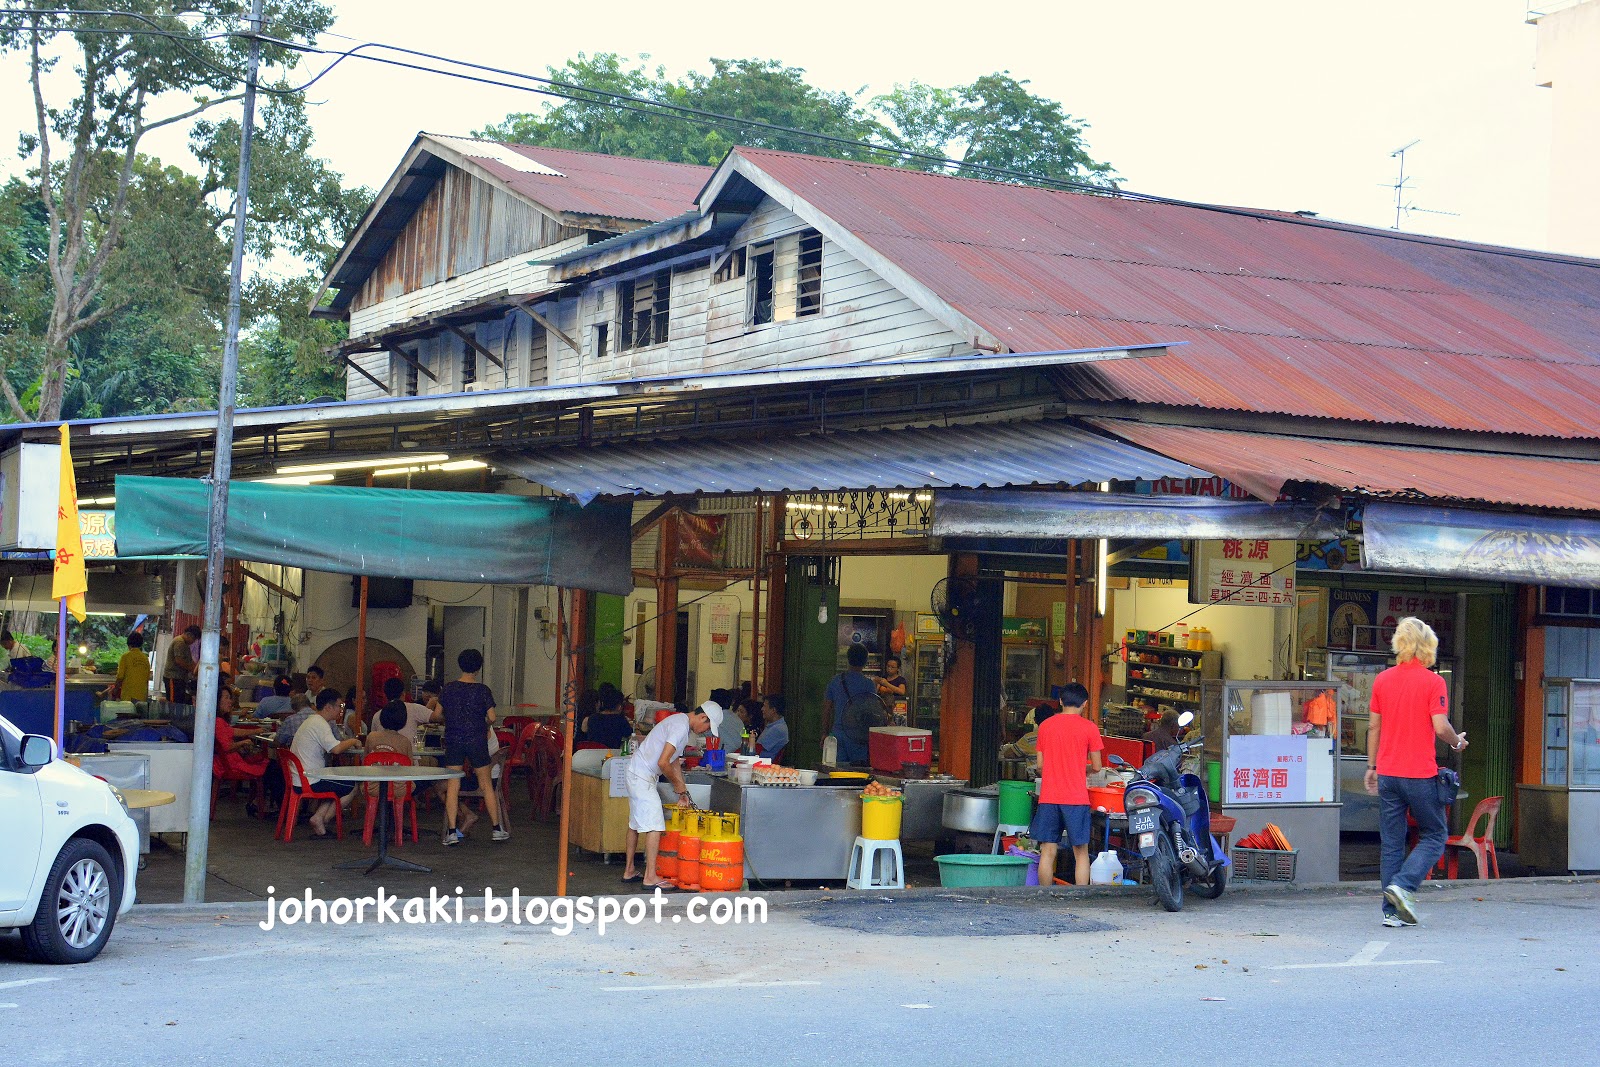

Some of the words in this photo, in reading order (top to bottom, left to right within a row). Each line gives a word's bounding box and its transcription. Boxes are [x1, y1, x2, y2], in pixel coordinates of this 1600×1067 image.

[1222, 538, 1269, 560] 桃源
[1333, 590, 1372, 601] GUINNESS
[1233, 767, 1288, 789] 經濟面
[1135, 816, 1152, 825] JJA
[1135, 822, 1155, 832] 5015
